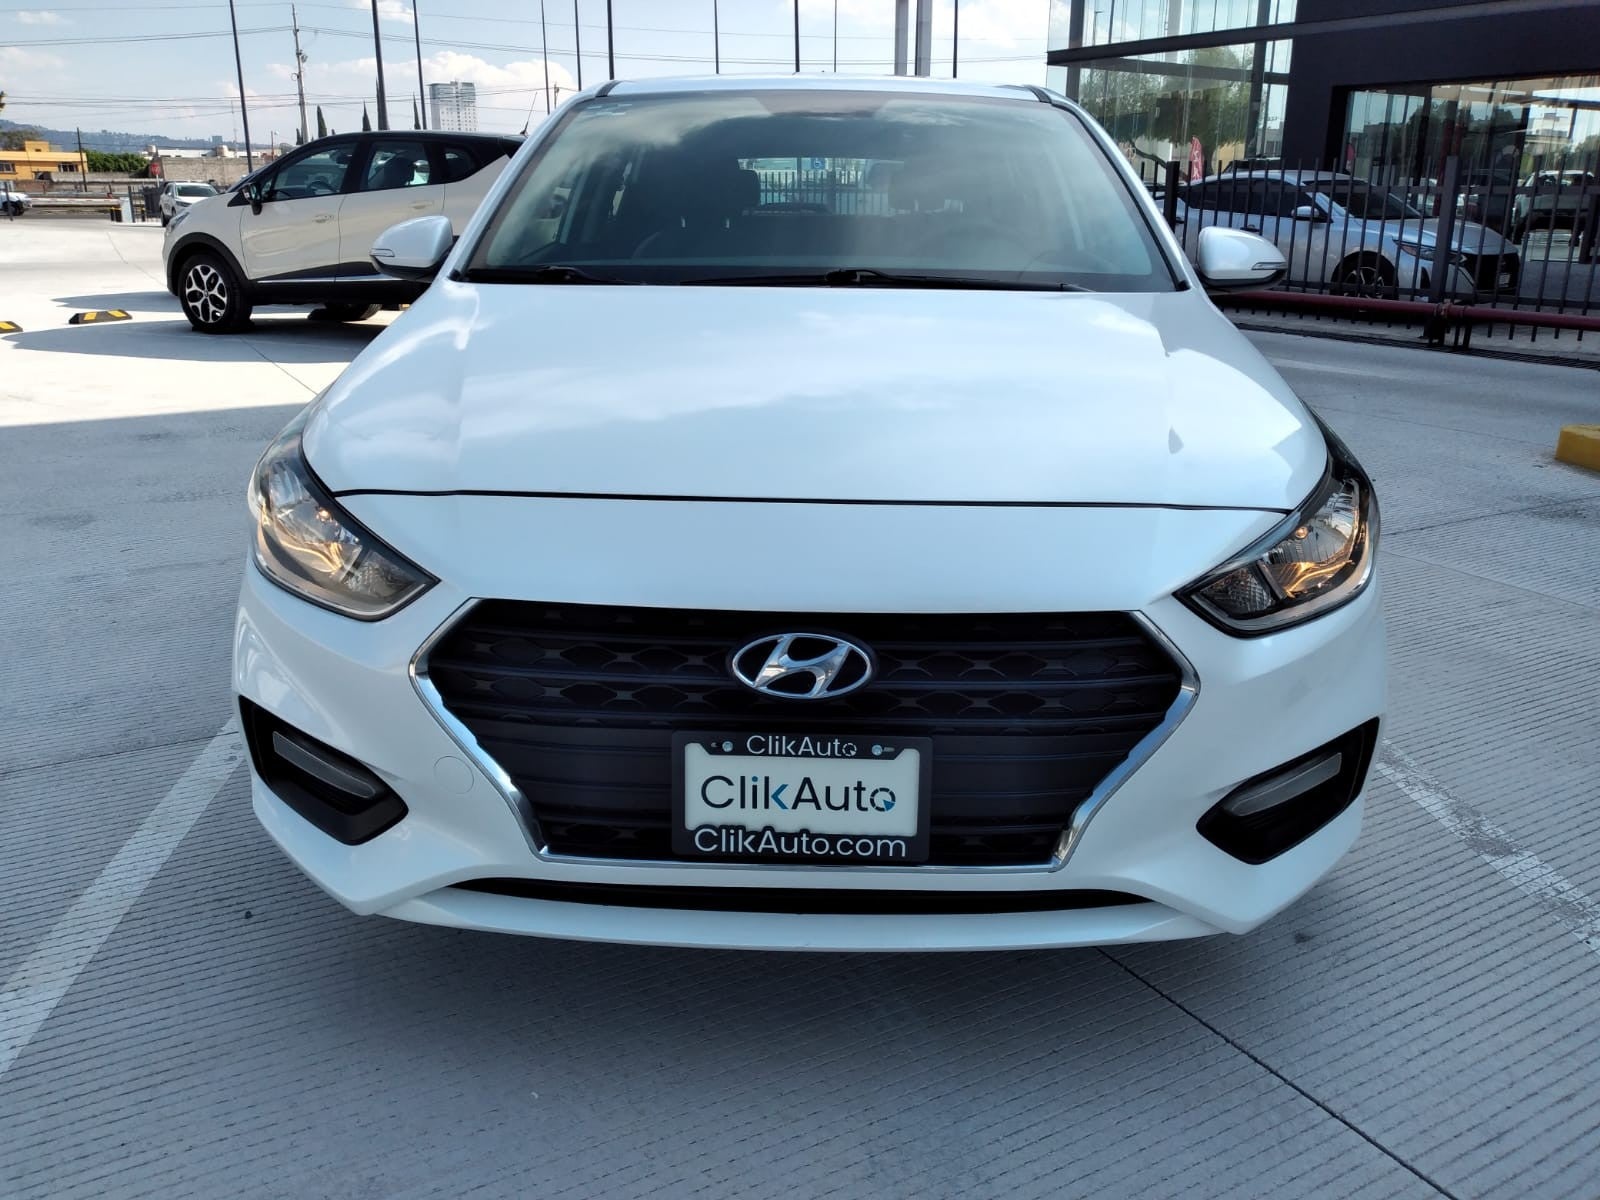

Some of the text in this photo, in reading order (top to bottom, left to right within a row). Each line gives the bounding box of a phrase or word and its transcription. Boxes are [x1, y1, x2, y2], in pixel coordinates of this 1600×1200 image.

[746, 735, 858, 757] ClikAuto
[701, 775, 896, 812] ClikAuto
[694, 828, 906, 857] ClikAuto.com
